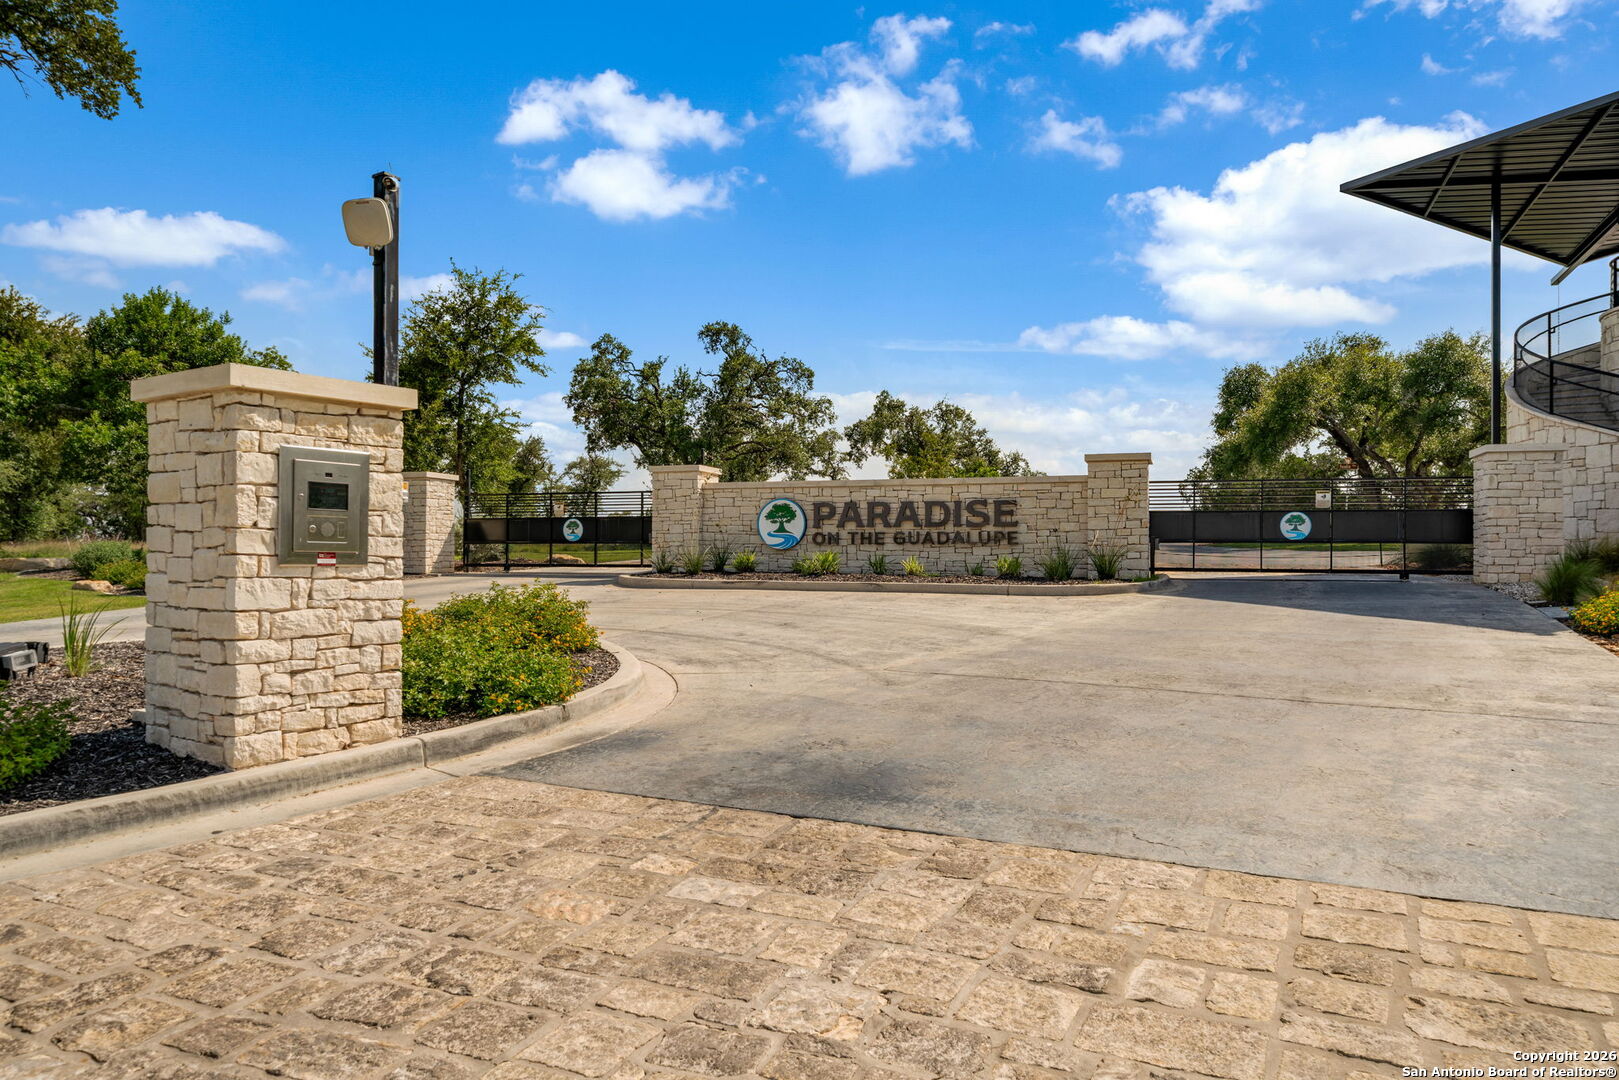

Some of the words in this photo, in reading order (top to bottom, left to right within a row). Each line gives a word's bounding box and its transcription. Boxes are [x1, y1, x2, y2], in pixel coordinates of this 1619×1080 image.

[812, 499, 1019, 528] PARADISE
[812, 531, 840, 546] ON
[848, 531, 885, 546] THE
[893, 530, 1019, 546] GUADALUPE
